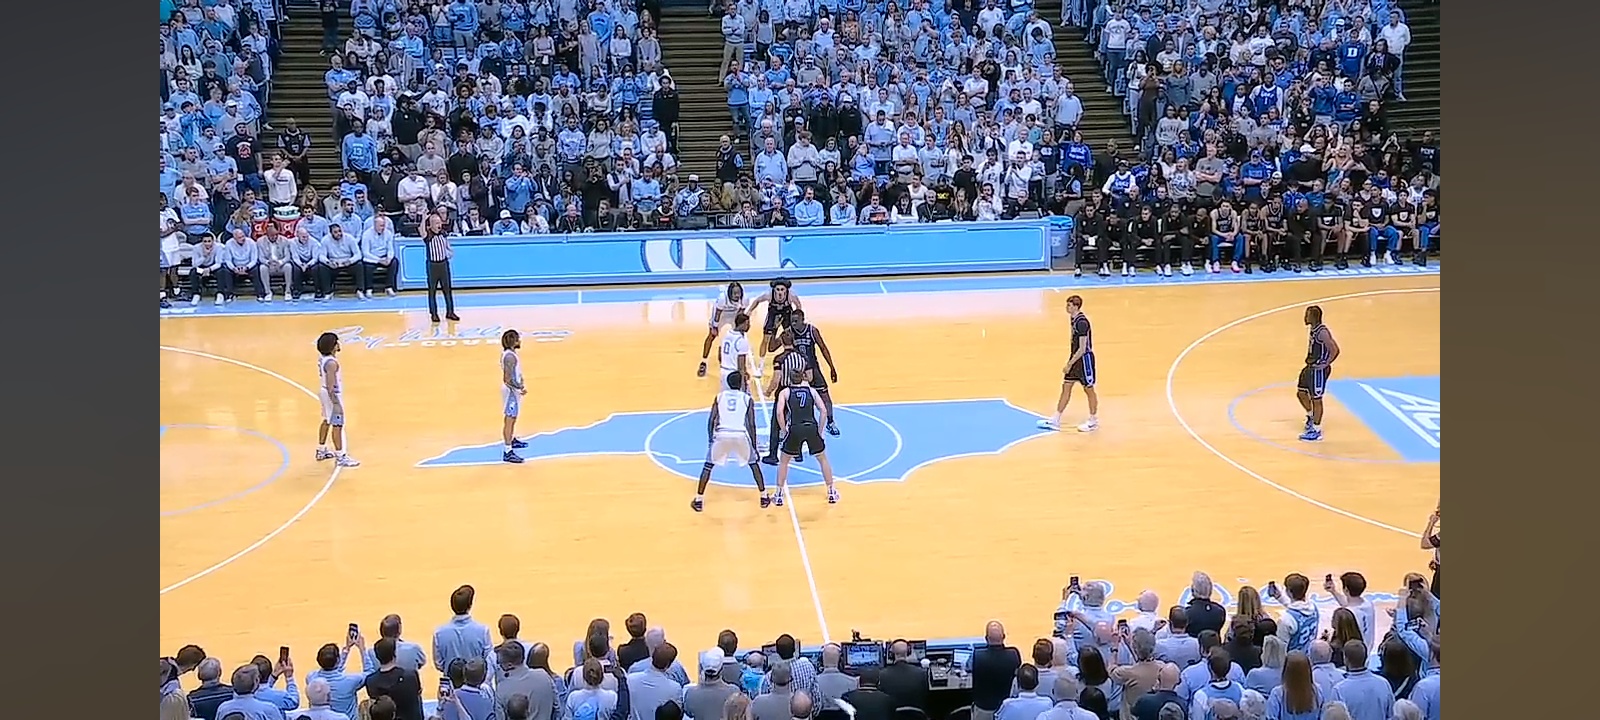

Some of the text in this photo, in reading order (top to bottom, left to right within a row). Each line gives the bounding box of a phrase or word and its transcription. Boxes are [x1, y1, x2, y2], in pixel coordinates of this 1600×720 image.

[1346, 47, 1358, 57] D
[723, 342, 731, 355] 0
[796, 391, 807, 407] 7
